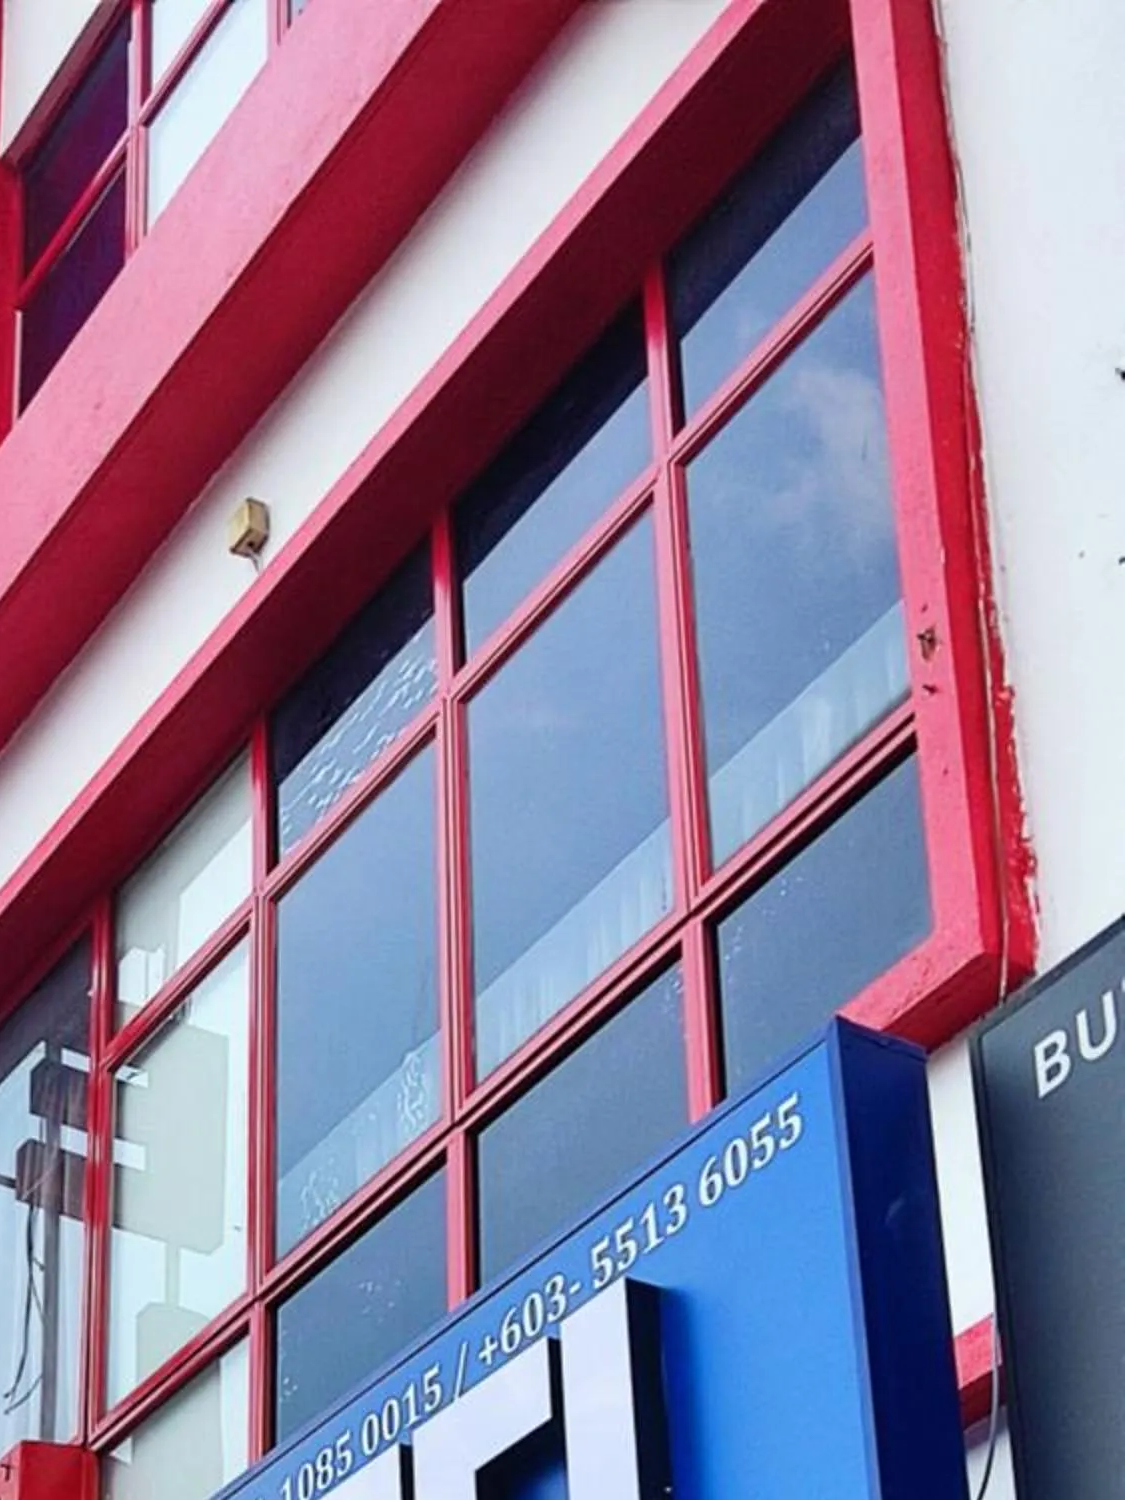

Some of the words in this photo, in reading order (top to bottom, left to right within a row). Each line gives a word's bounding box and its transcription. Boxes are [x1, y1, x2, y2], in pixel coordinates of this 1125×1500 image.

[1032, 978, 1125, 1099] BU
[360, 1364, 443, 1457] 0015
[478, 1273, 581, 1367] +603-
[589, 1184, 688, 1290] 5513
[697, 1092, 804, 1208] 6055
